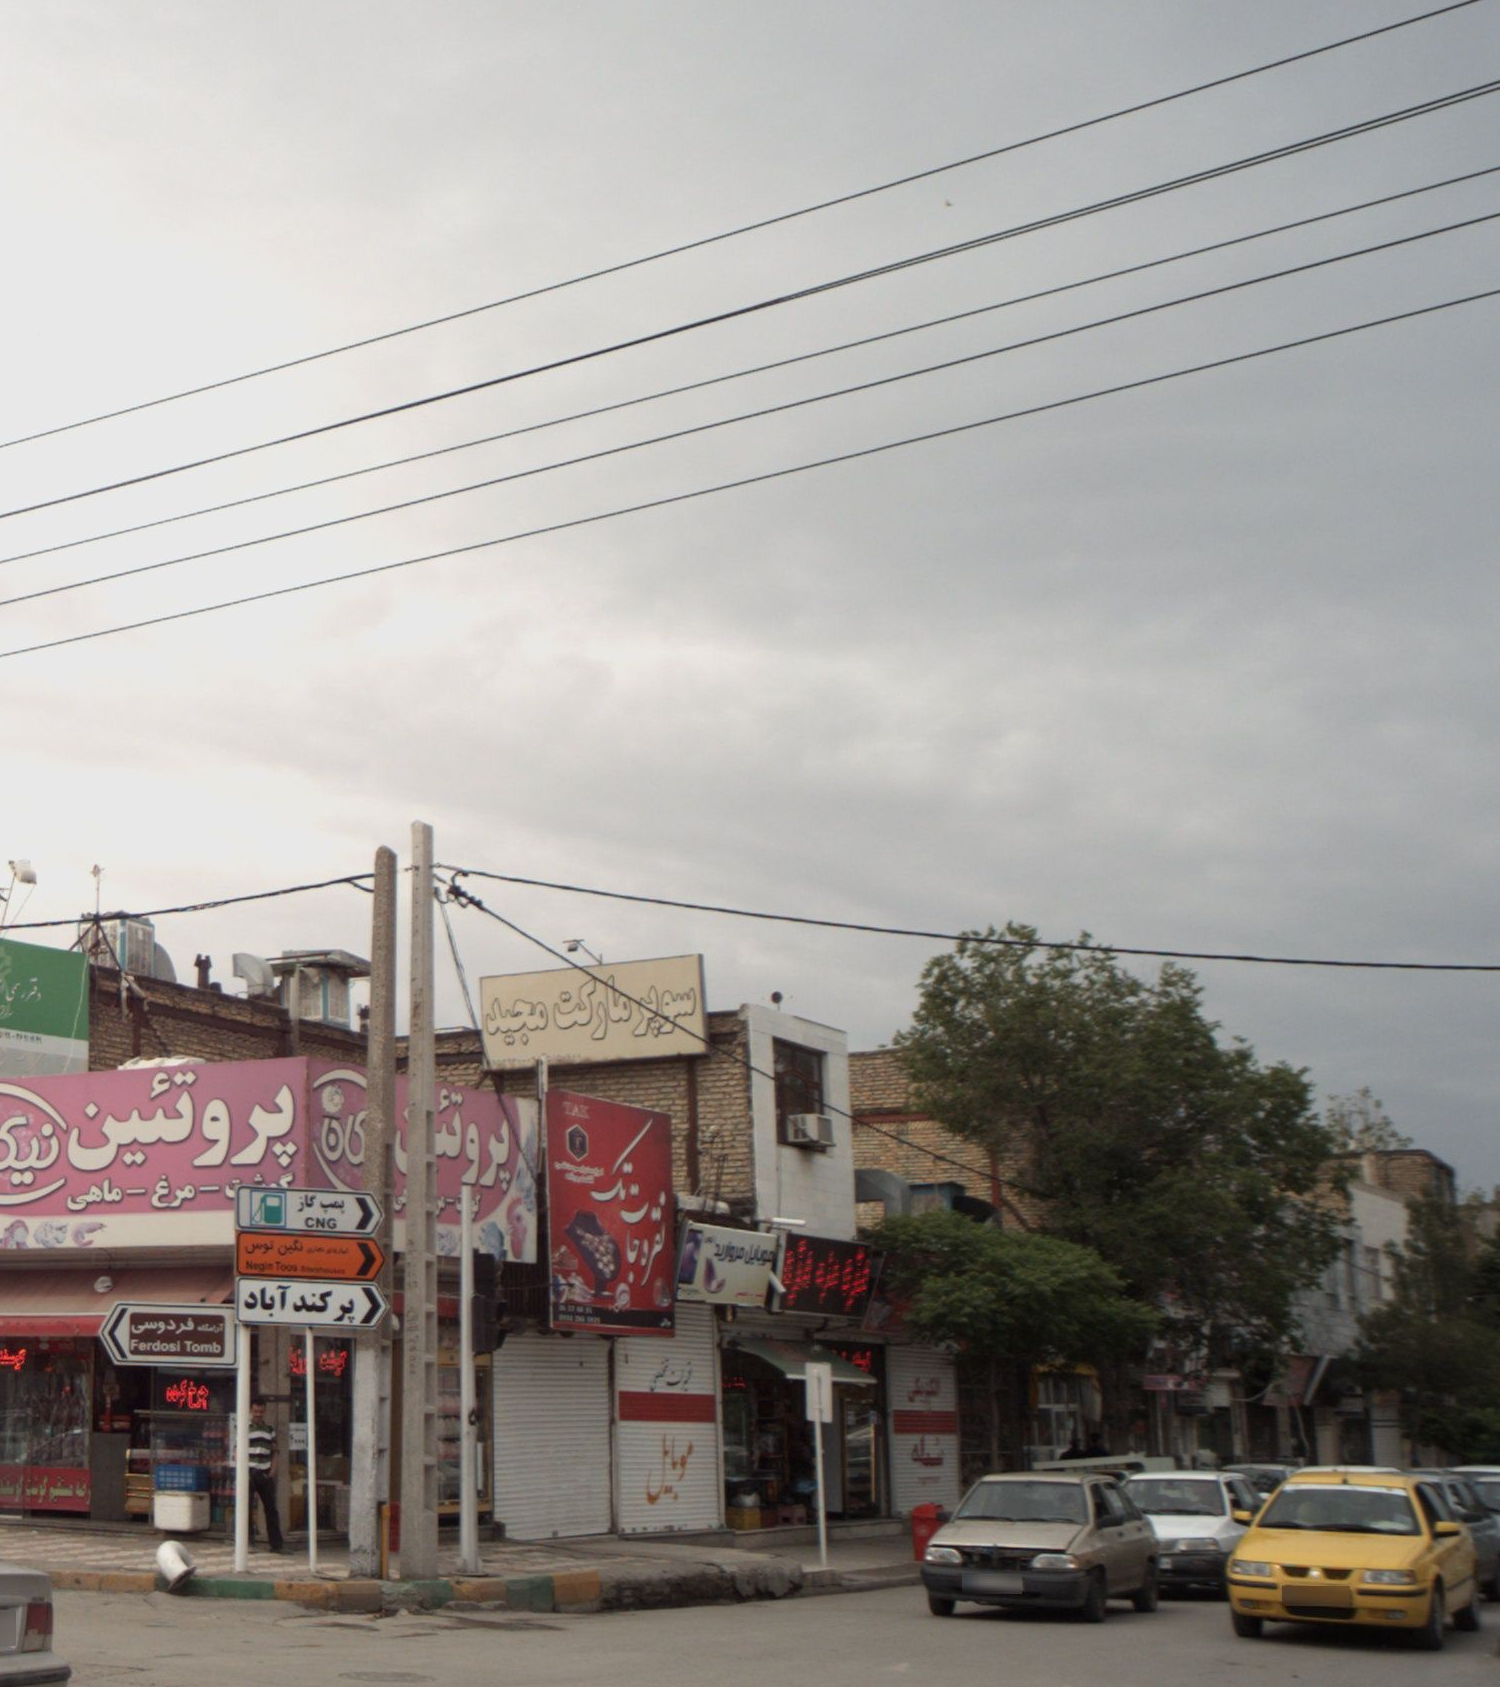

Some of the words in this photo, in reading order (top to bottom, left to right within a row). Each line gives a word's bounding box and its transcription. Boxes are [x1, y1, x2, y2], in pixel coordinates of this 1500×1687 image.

[633, 985, 697, 1037] سوپر
[562, 1101, 590, 1119] TAK
[66, 1070, 299, 1170] پروتئین
[66, 1178, 123, 1212] ماهی
[150, 1173, 196, 1208] مرغ
[297, 1194, 317, 1212] گاز
[320, 1200, 346, 1214] پمپ
[304, 1217, 337, 1229] CNG
[131, 1318, 195, 1334] فردوسی
[130, 1339, 180, 1352] Ferdosi
[184, 1341, 222, 1353] Tomb
